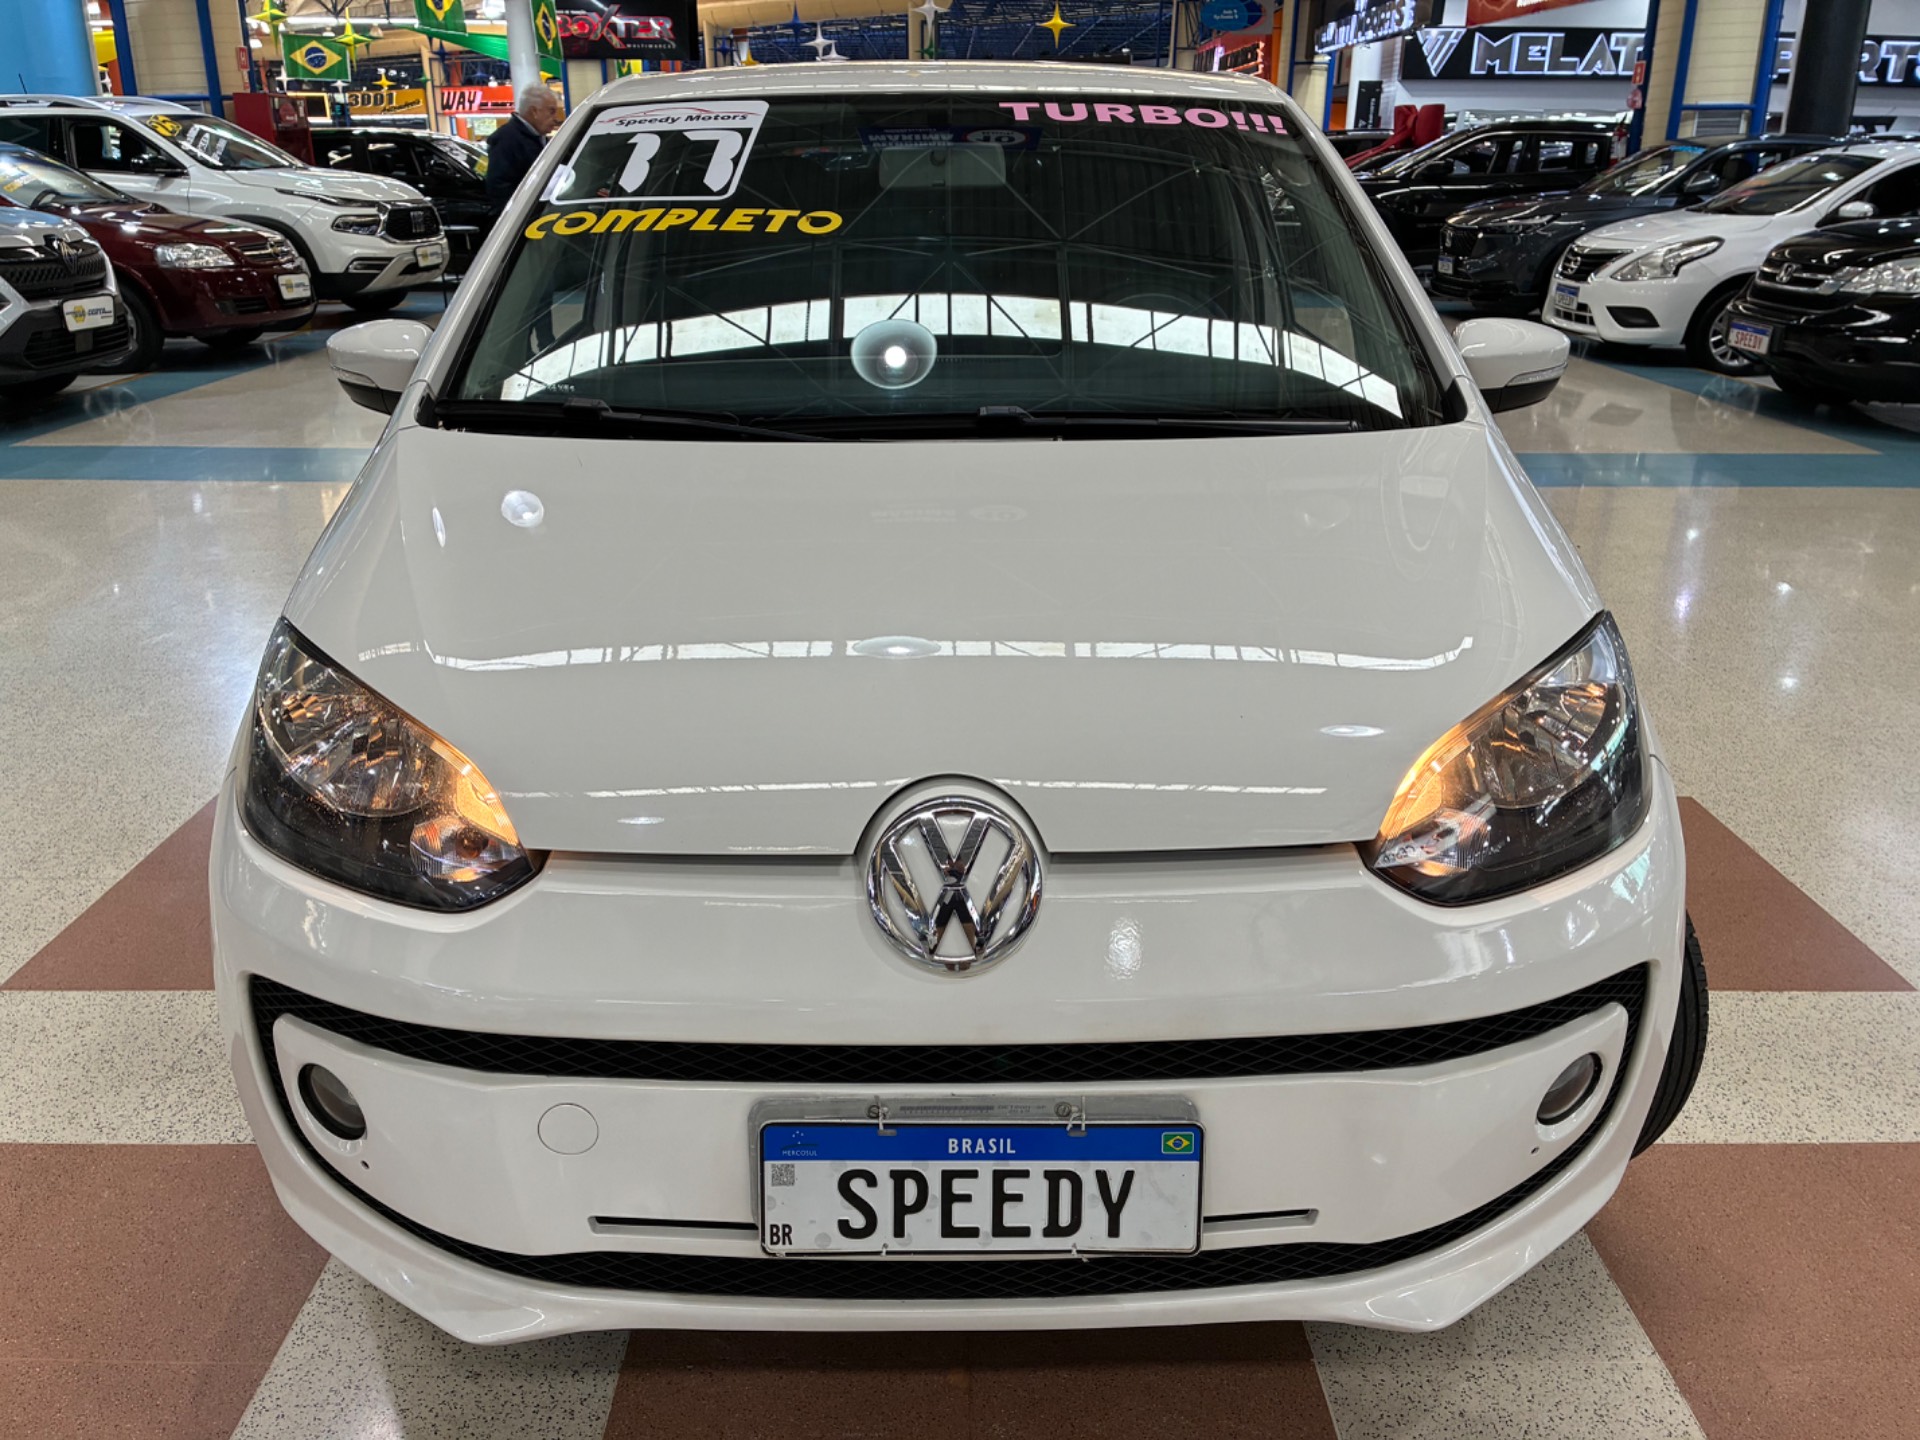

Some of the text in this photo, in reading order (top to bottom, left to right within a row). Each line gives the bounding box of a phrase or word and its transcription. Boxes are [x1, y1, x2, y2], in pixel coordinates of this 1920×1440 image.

[556, 4, 675, 49] BOXTER
[441, 90, 481, 111] WAY
[615, 113, 748, 127] Speedy Motors
[998, 102, 1288, 135] TURBO!!!
[618, 129, 743, 193] 17
[524, 207, 843, 240] COMPLETO
[1735, 333, 1764, 351] SPEEDY
[782, 1149, 818, 1157] MERCOSUL
[948, 1137, 1016, 1155] BRASIL
[837, 1168, 1136, 1240] SPEEDY
[769, 1224, 793, 1246] BR
